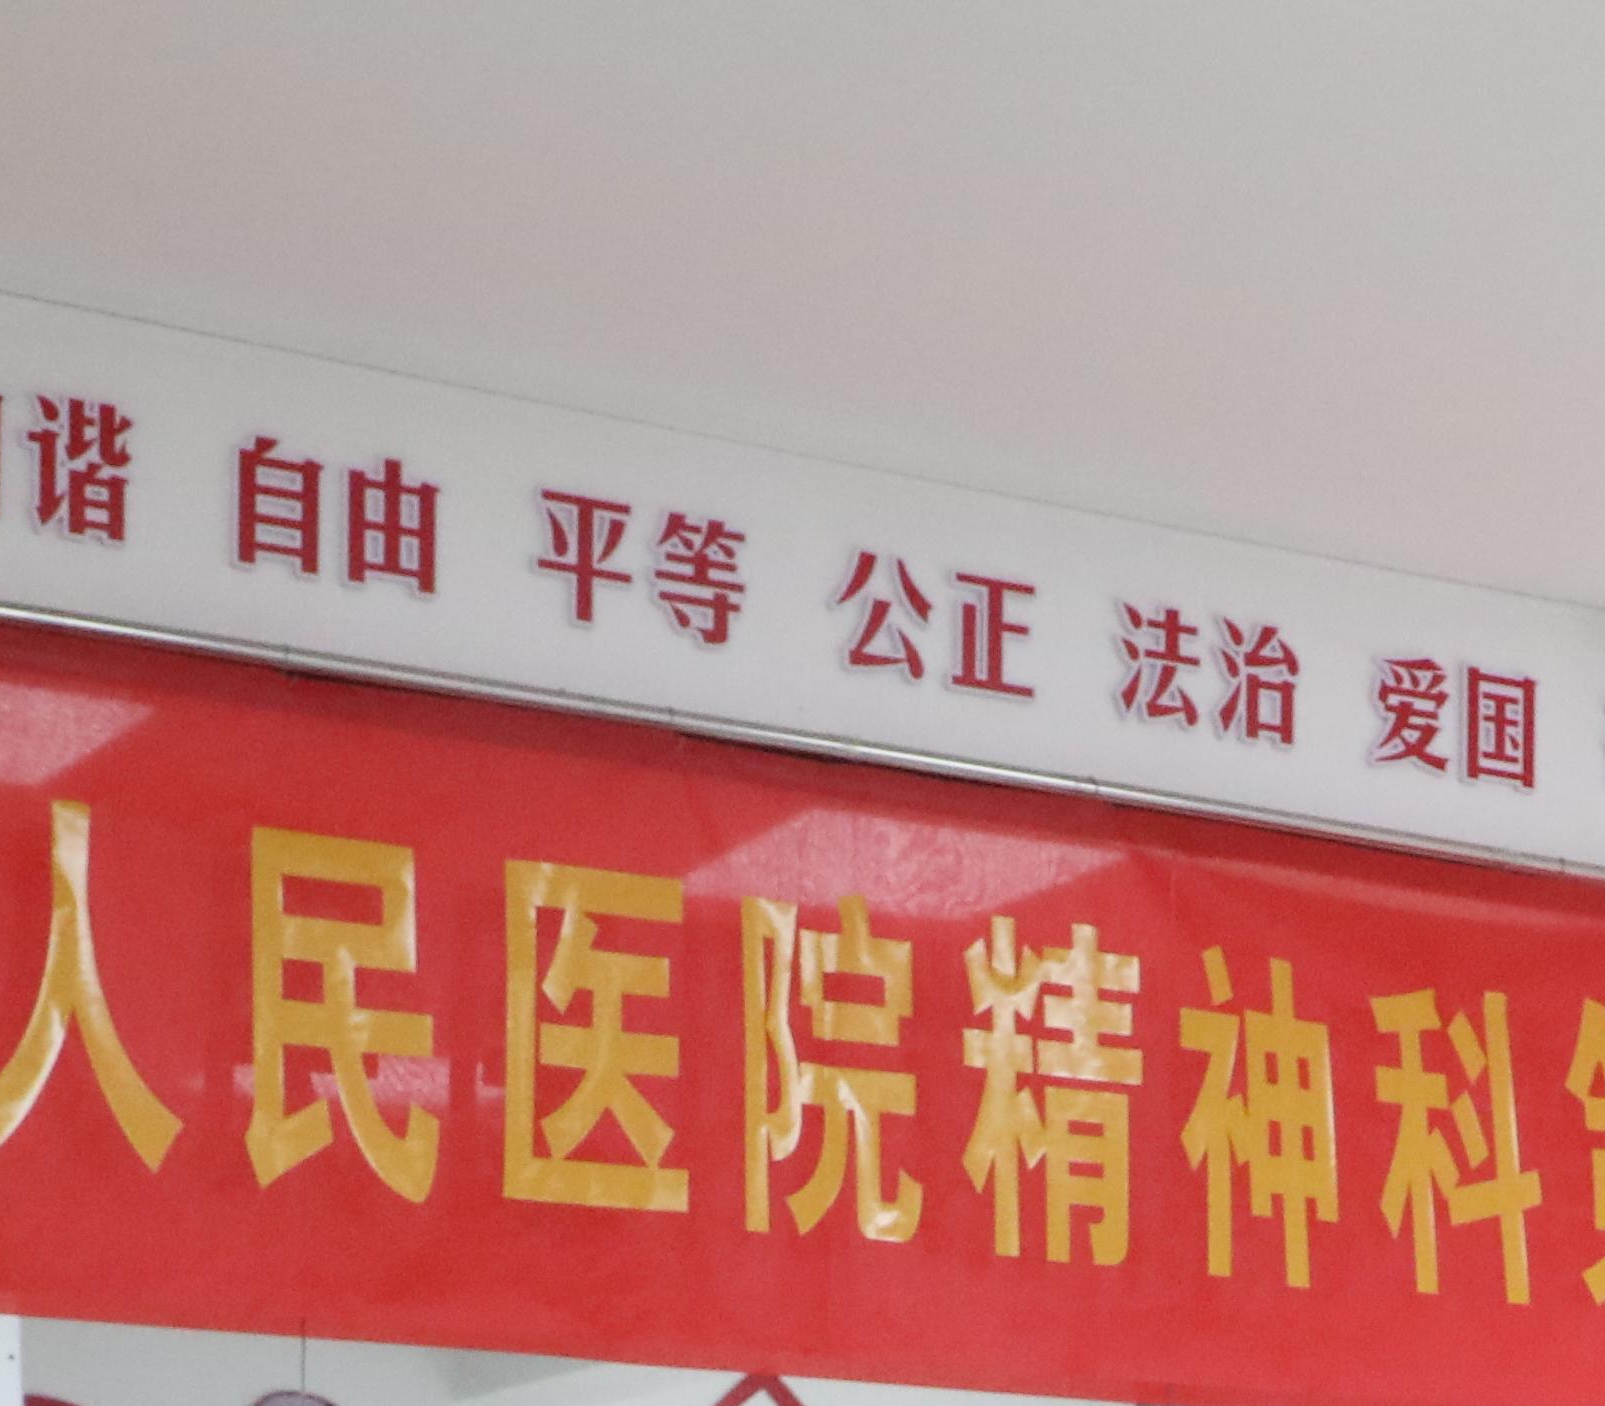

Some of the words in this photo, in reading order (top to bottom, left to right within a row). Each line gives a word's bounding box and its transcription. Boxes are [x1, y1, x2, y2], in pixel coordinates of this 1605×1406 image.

[235, 436, 440, 595] 自由
[537, 489, 746, 645] 平等
[839, 551, 1037, 698] 公正
[1120, 605, 1300, 745] 法治
[1377, 657, 1538, 789] 爱国
